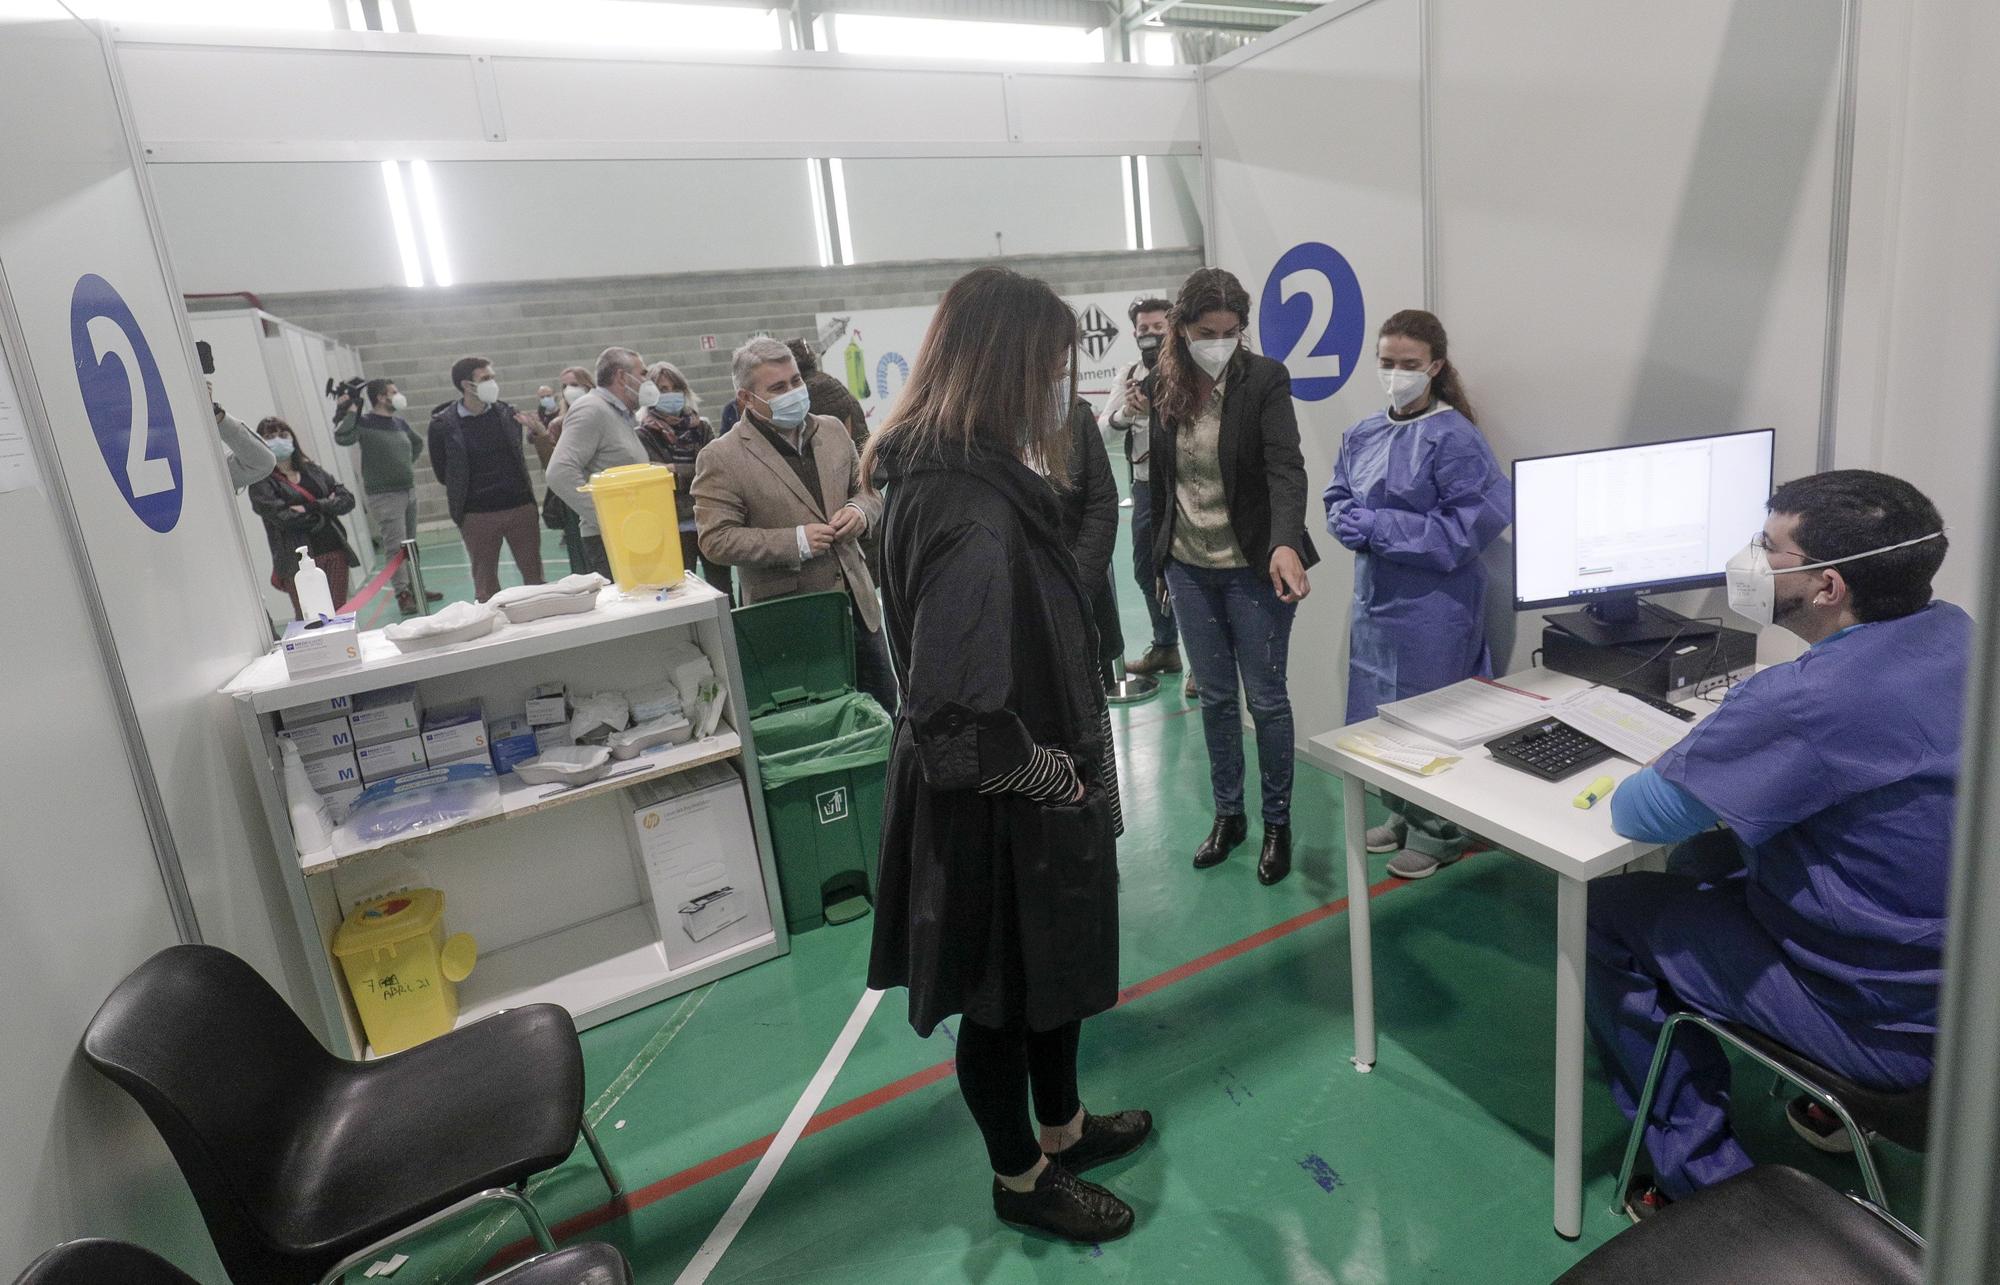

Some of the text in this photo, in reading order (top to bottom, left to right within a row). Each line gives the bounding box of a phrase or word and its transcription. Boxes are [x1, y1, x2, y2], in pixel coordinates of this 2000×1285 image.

[1280, 268, 1340, 377] 2
[86, 315, 176, 498] 2
[345, 645, 357, 658] S
[405, 718, 415, 728] L
[333, 732, 349, 746] M
[475, 735, 484, 746] S
[412, 752, 421, 762] L
[338, 767, 354, 781] M
